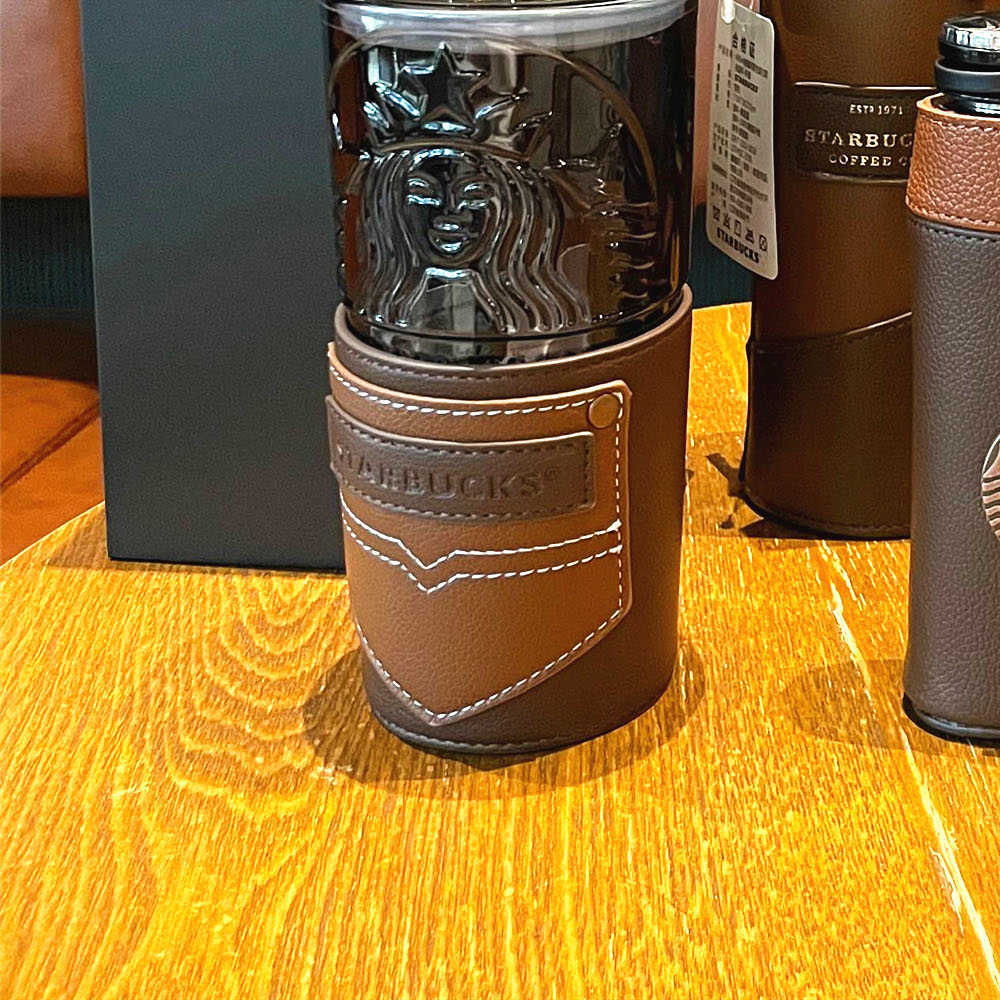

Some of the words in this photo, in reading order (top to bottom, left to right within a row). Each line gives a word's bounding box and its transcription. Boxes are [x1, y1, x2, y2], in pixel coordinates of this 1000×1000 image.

[877, 104, 903, 116] 1971
[804, 128, 913, 148] STARBUC
[828, 154, 892, 167] COFFEE
[716, 226, 760, 264] STARBUCKS
